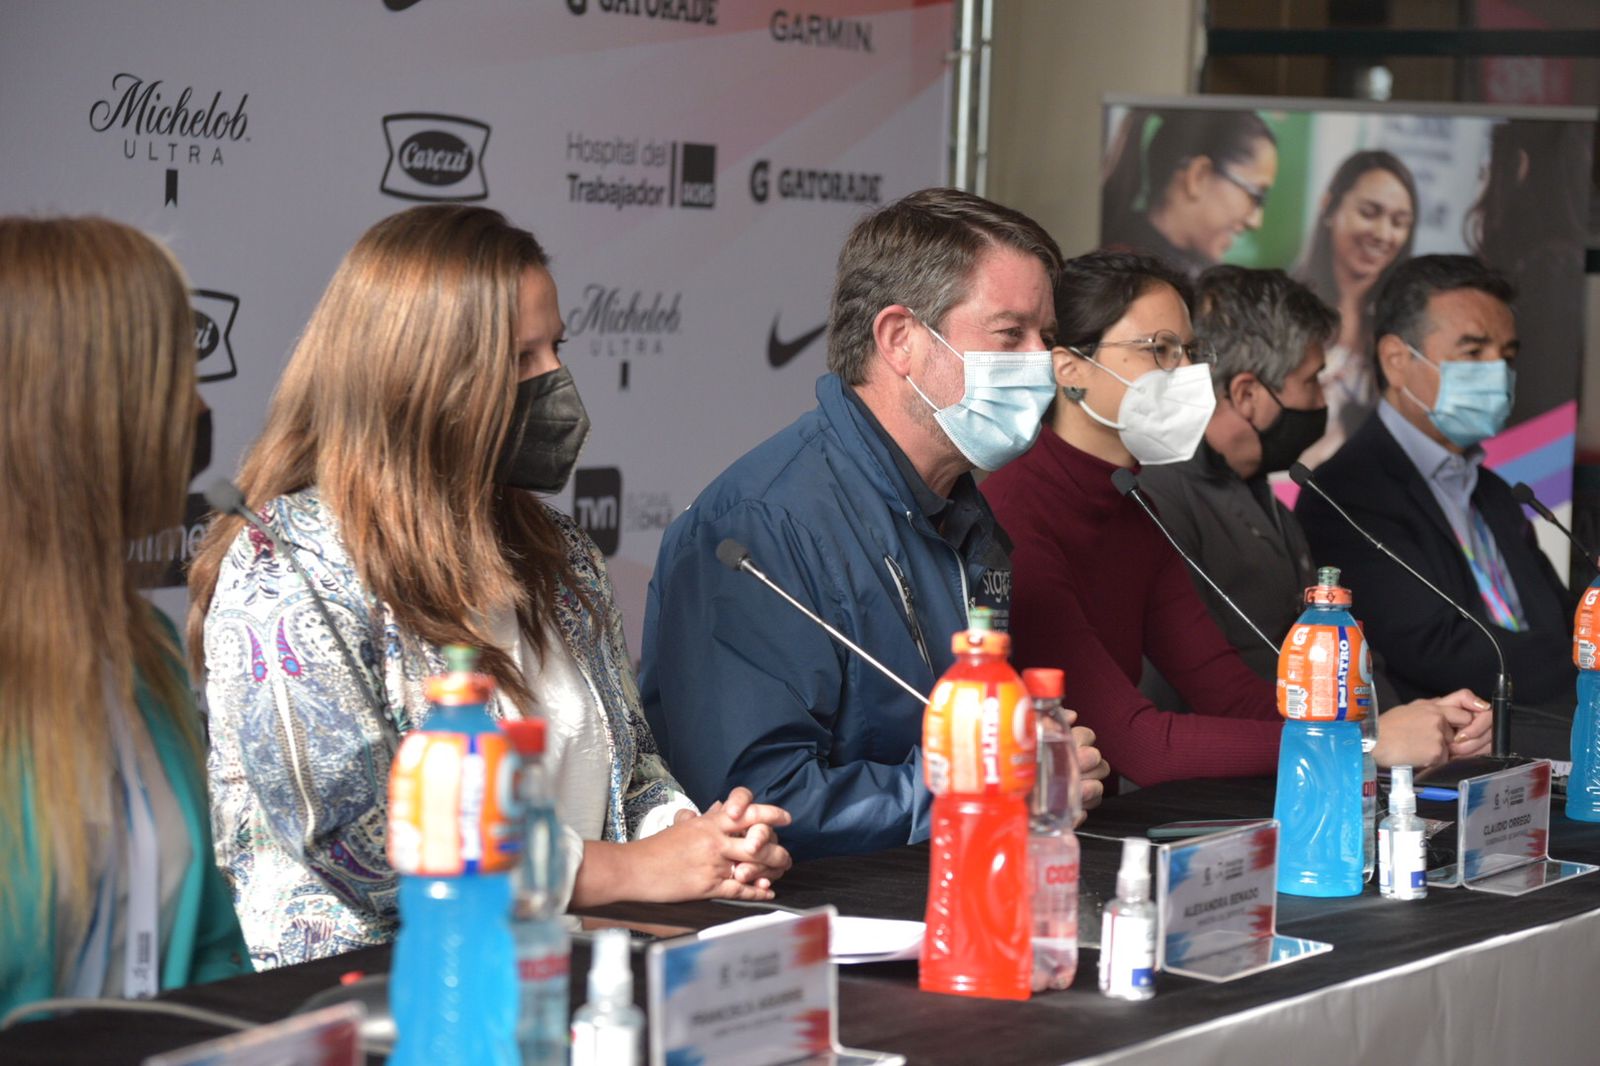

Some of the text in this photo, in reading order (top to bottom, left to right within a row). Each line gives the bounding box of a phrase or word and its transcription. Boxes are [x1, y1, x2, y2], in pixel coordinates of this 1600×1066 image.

[769, 10, 875, 53] GARMIN
[90, 73, 250, 142] Michelob
[124, 139, 224, 165] ULTRA
[566, 131, 667, 170] Hospital del
[566, 173, 665, 211] Trabajador
[778, 168, 882, 203] GATORADE
[1483, 813, 1532, 836] CLAUDIO ORREGO
[1184, 895, 1229, 918] ALEXANDRA
